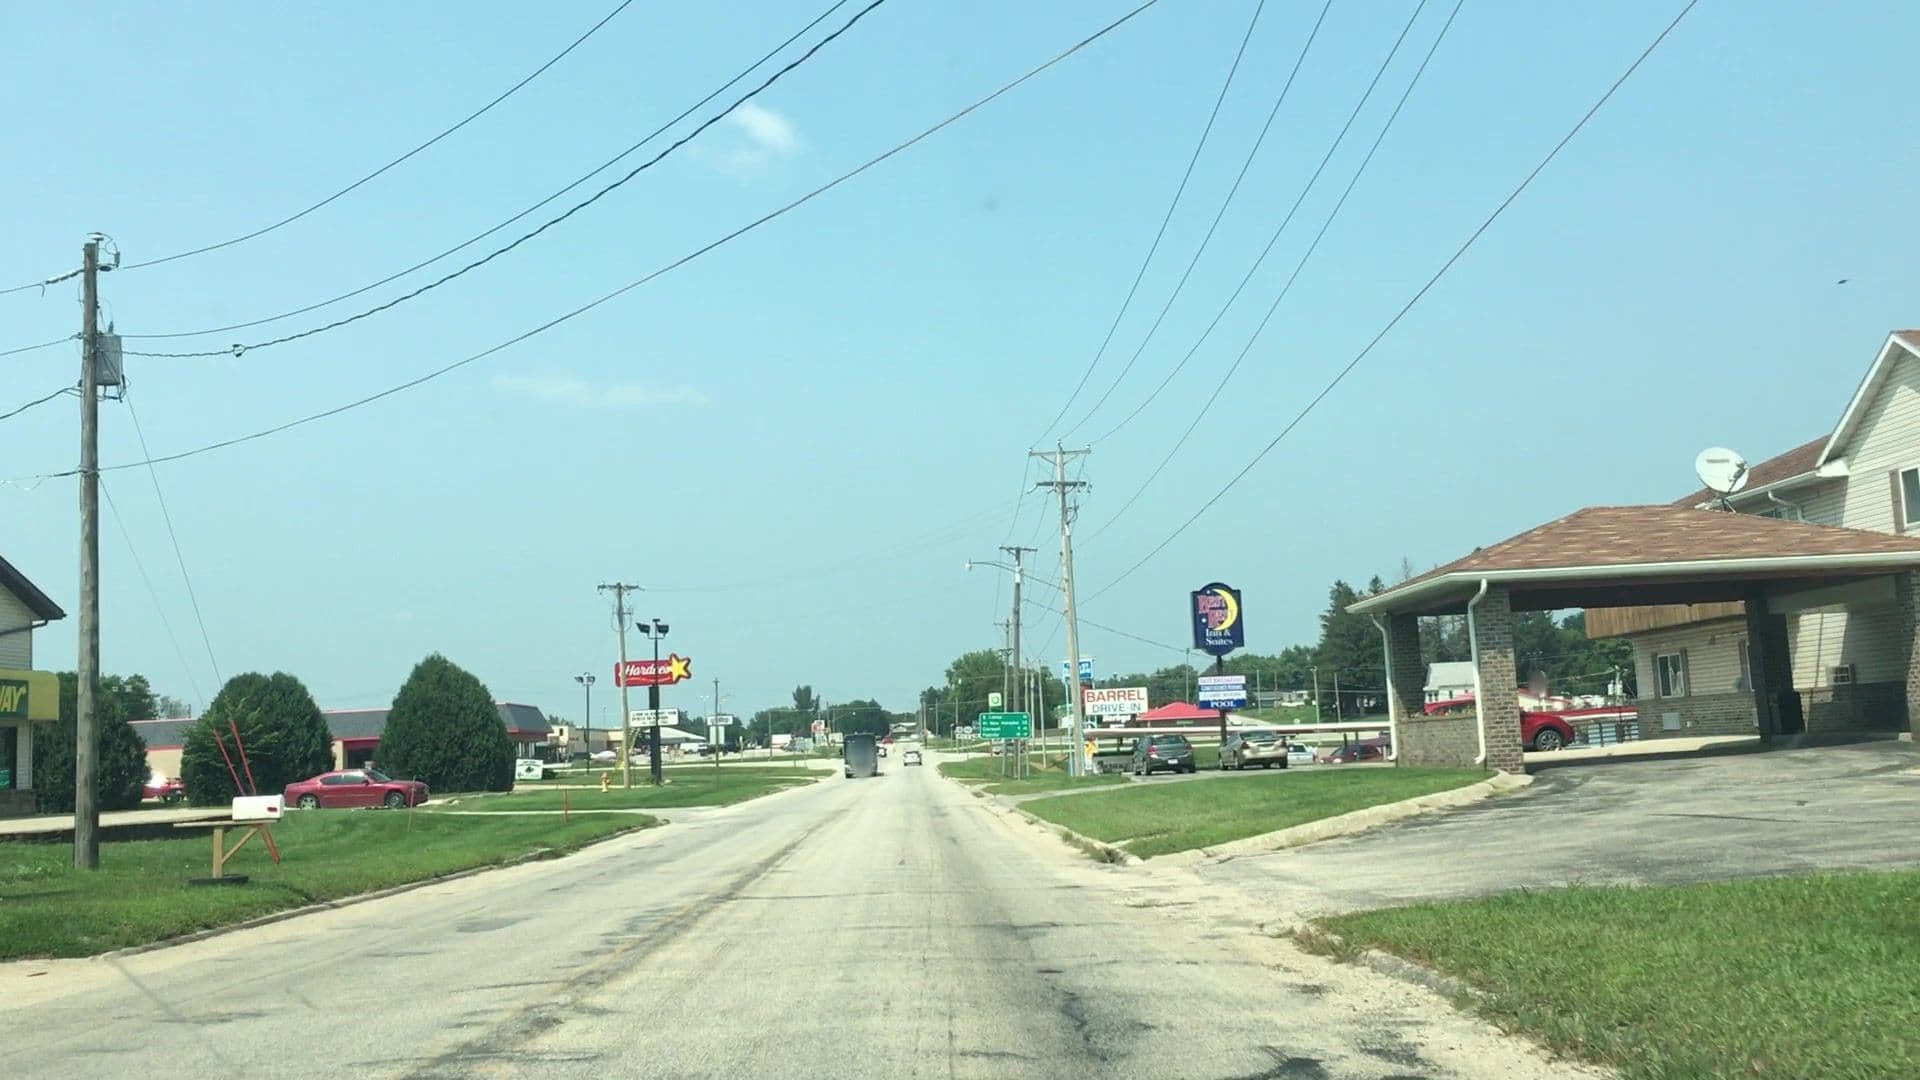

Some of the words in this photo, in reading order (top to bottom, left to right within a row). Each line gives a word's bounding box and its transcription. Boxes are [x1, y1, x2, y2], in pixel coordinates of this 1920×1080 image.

[1206, 628, 1222, 637] Inn
[0, 684, 26, 712] AY
[1086, 689, 1144, 702] BARREL
[1210, 700, 1237, 708] POOL
